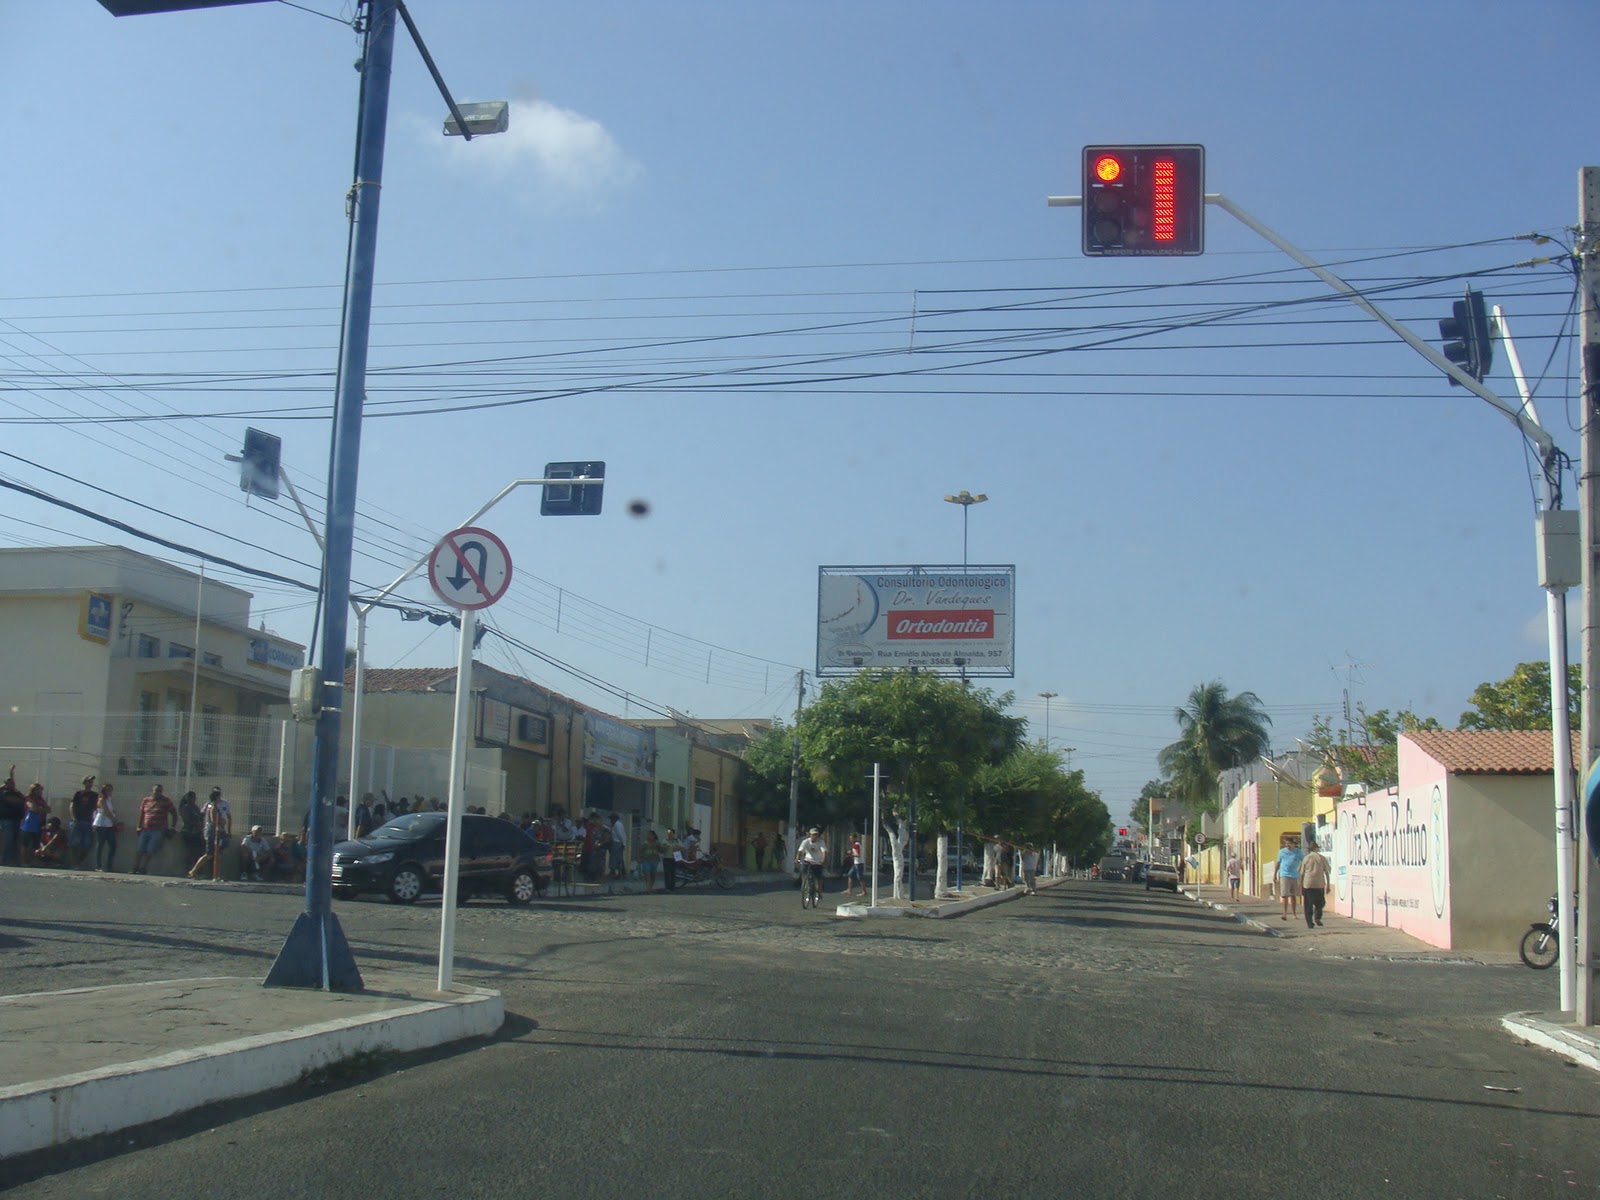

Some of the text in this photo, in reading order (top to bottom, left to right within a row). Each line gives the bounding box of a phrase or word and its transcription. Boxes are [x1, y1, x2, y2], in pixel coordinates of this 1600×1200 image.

[877, 576, 1006, 589] Consultorio Odontologico
[893, 591, 915, 605] Dr.
[896, 619, 988, 634] Ortodontia
[1363, 810, 1390, 866] Sarah
[1391, 798, 1428, 866] Rufino
